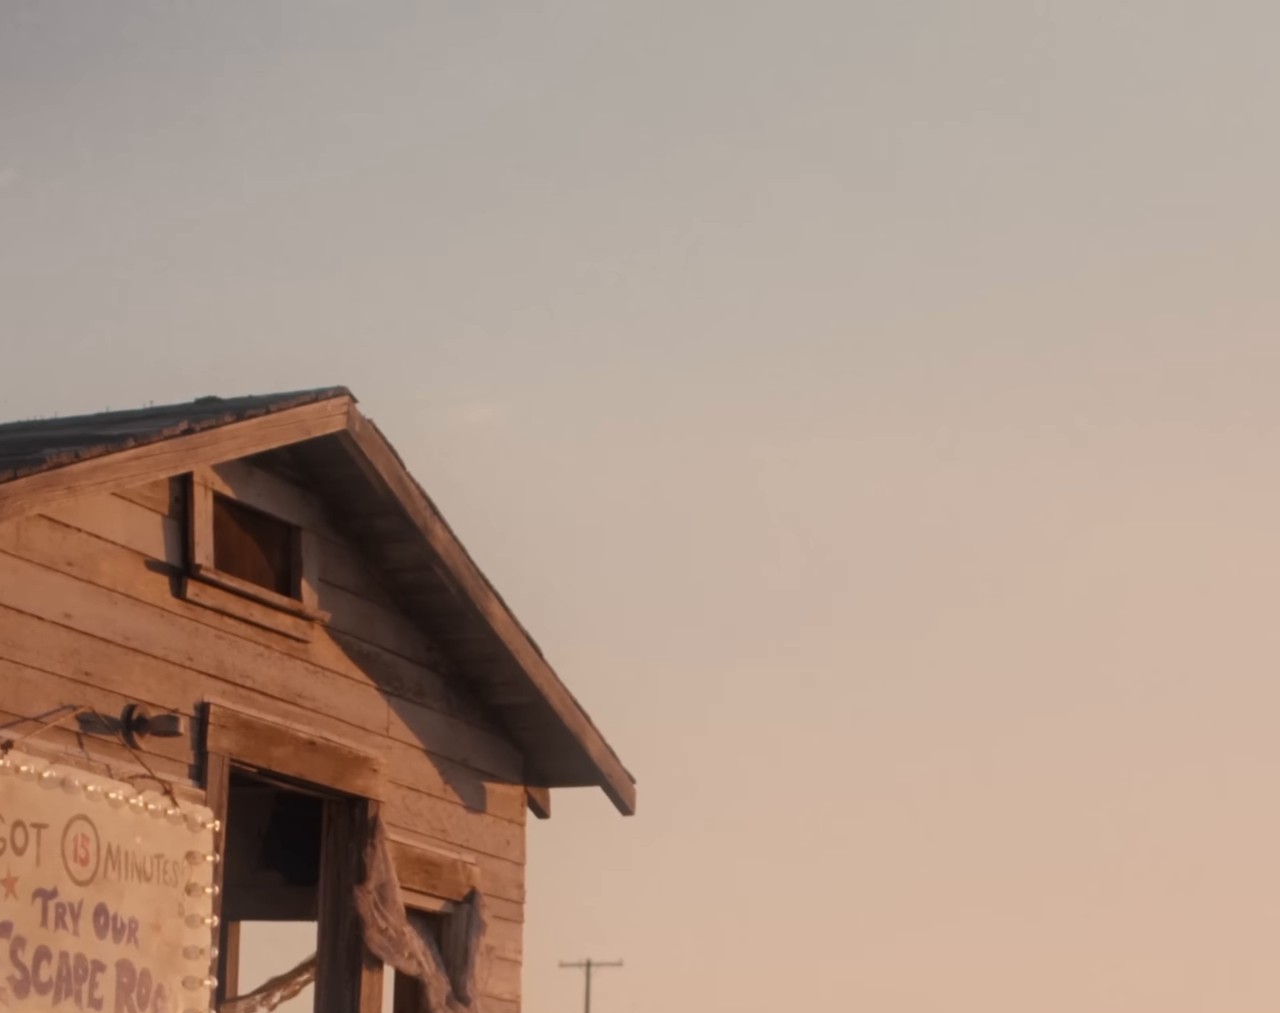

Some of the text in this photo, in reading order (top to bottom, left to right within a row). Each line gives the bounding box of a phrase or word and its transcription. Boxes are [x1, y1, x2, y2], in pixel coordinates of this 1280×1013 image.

[71, 832, 90, 868] 15
[32, 886, 140, 950] TRY OUR
